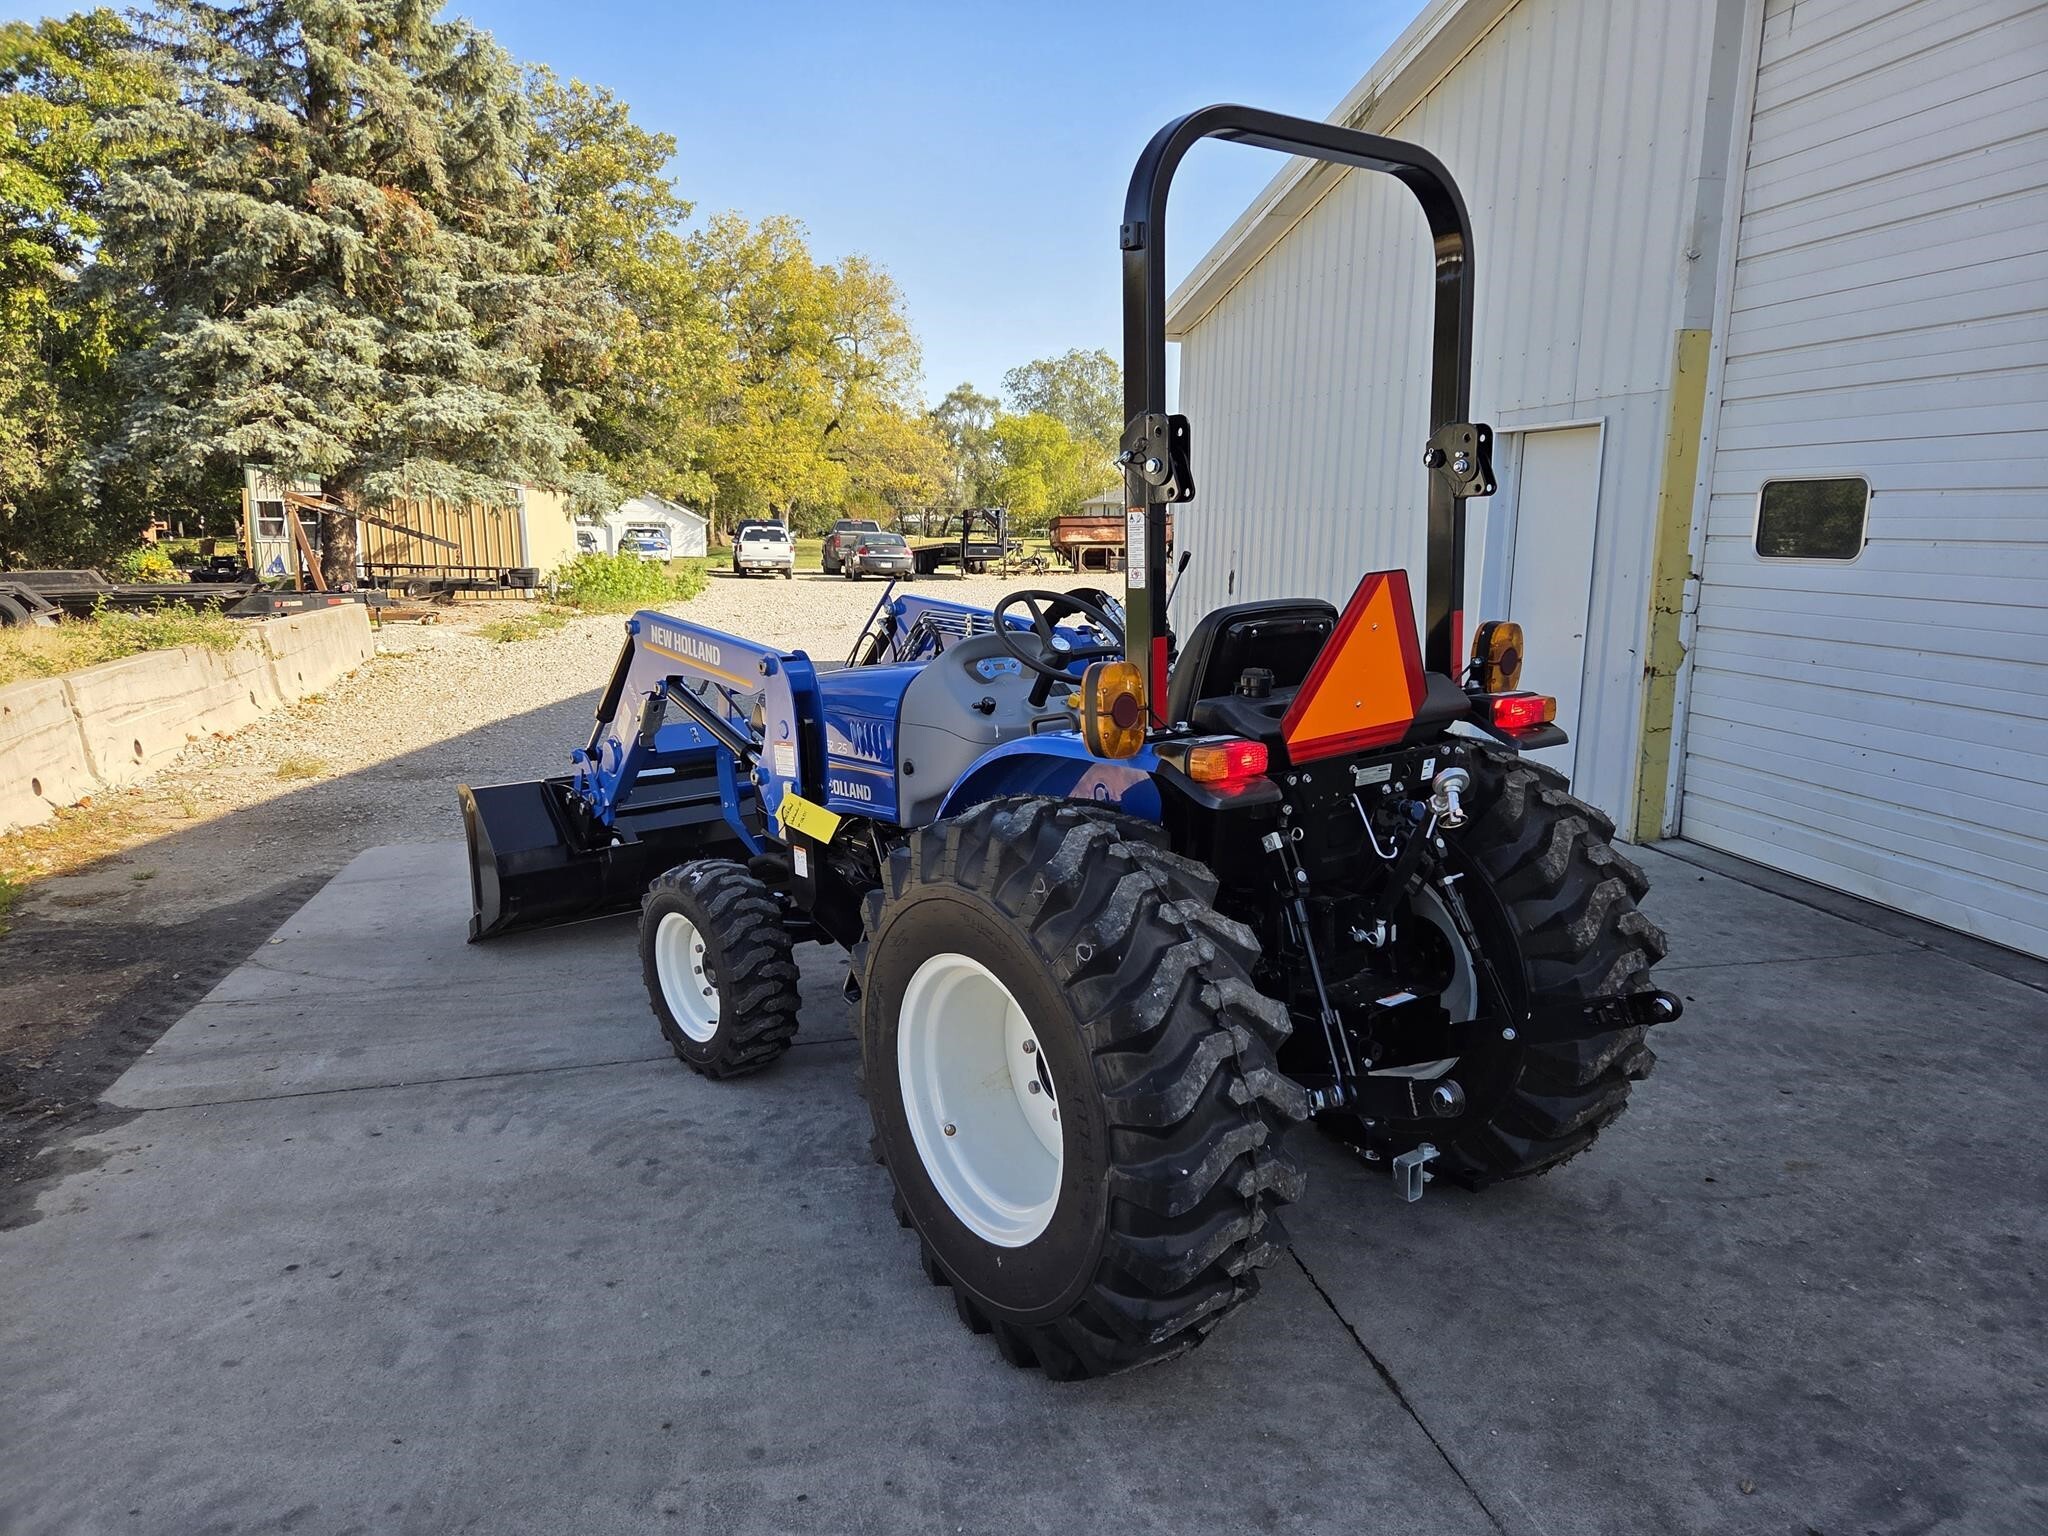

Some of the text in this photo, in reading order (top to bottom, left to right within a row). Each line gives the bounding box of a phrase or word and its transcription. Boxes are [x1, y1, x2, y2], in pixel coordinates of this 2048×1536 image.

[650, 624, 721, 667] NEW HOLLAND
[837, 742, 848, 755] 25
